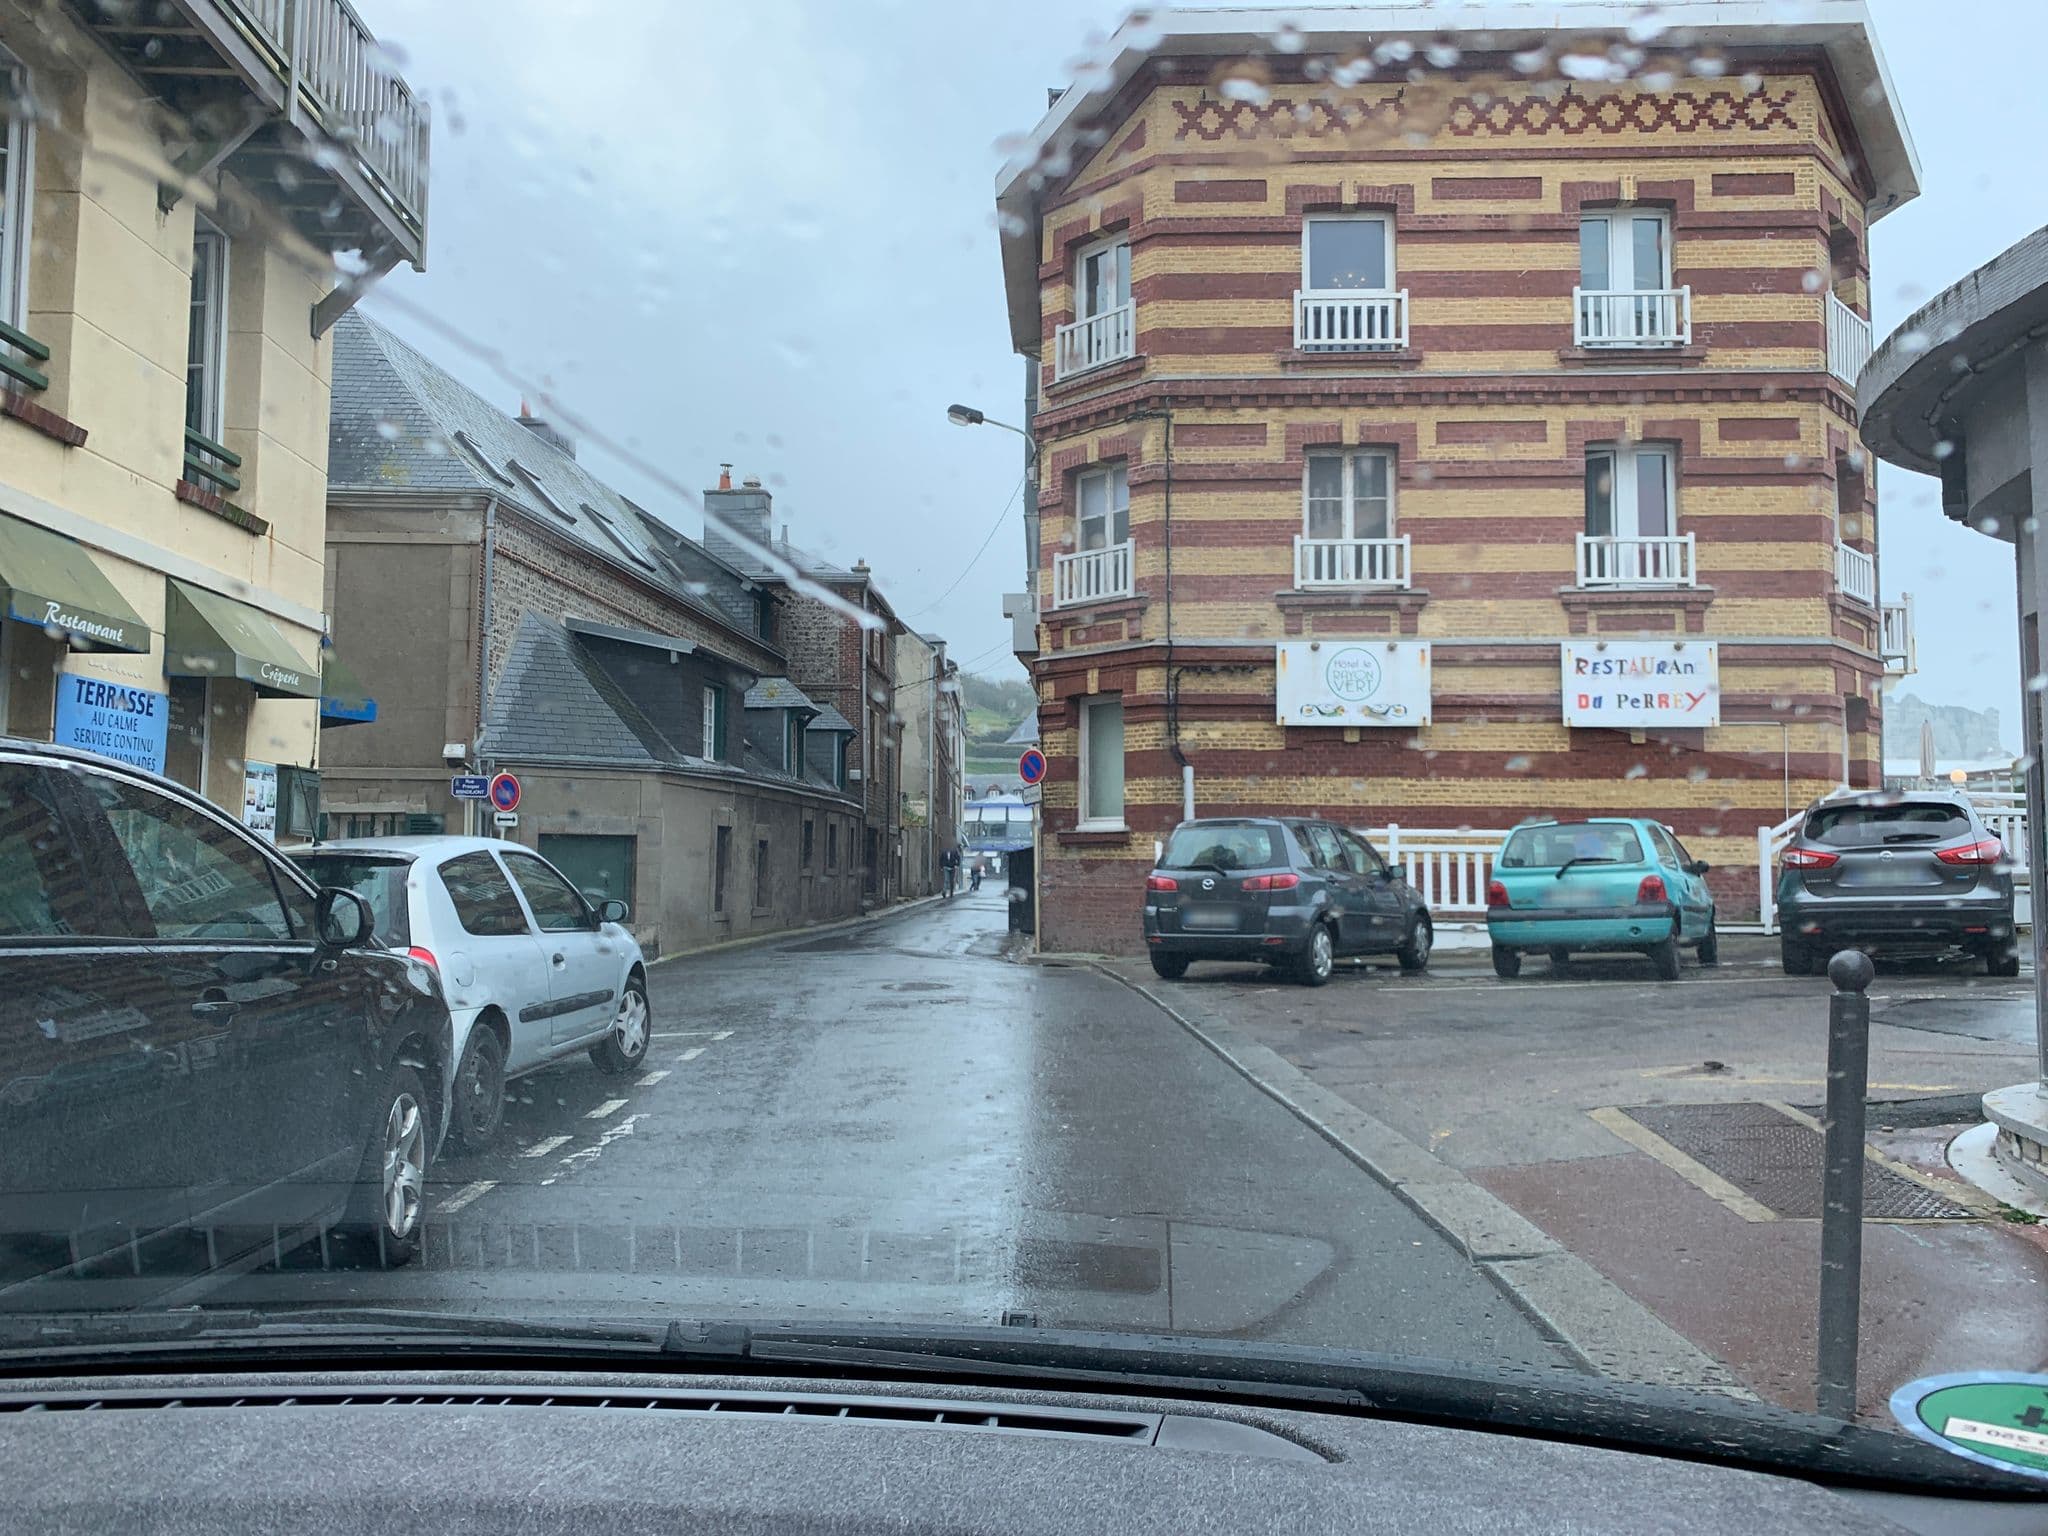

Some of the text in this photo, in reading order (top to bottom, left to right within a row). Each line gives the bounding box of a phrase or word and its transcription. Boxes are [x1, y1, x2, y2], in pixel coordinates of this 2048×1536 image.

[43, 601, 123, 641] Restaurant
[261, 663, 299, 687] Crêperie
[1333, 679, 1374, 692] VERT
[76, 679, 155, 717] TERRASSE
[91, 711, 138, 732] AU CALME
[73, 727, 112, 747] SERVICE
[114, 734, 154, 753] CONTINU
